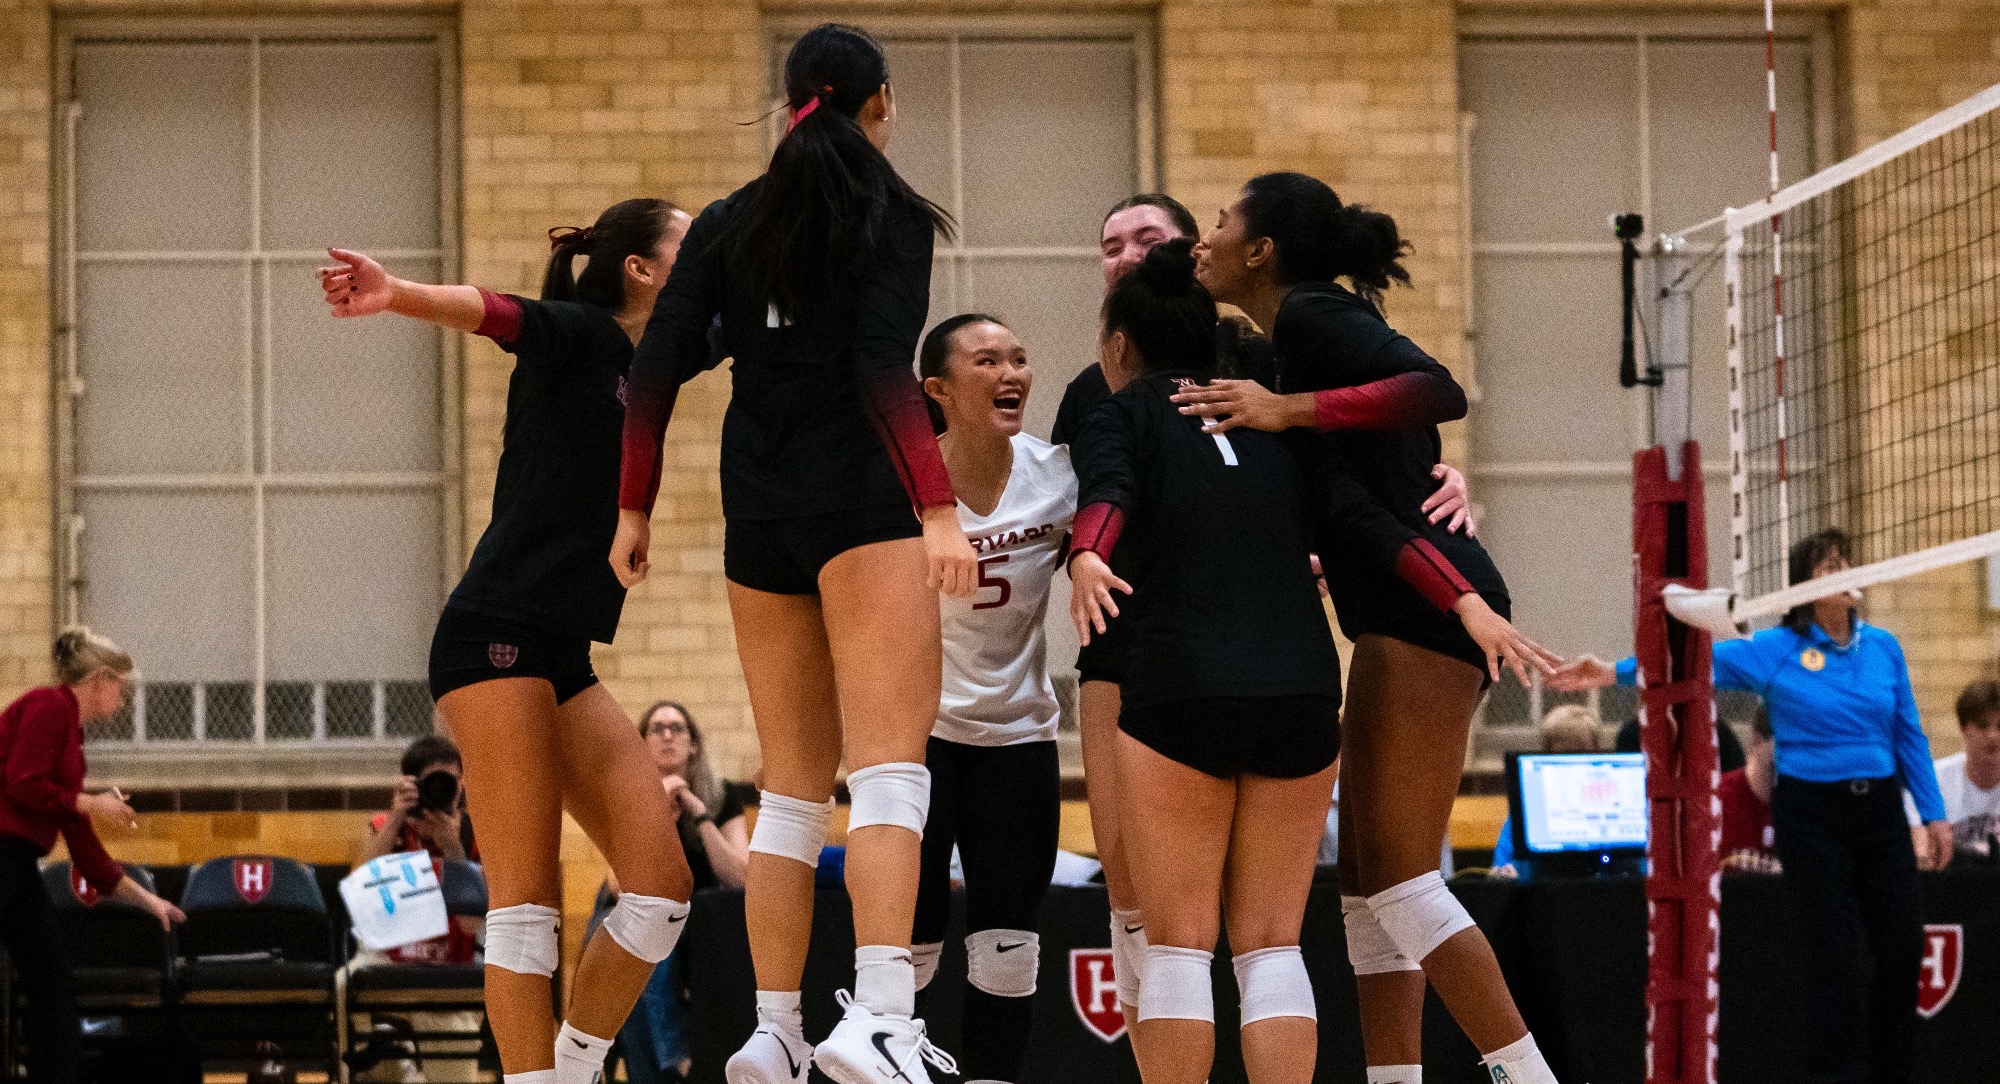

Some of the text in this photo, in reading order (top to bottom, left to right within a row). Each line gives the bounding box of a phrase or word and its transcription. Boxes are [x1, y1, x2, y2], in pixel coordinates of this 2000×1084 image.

[972, 554, 1012, 610] 5
[242, 863, 264, 892] H
[1088, 961, 1122, 1014] H
